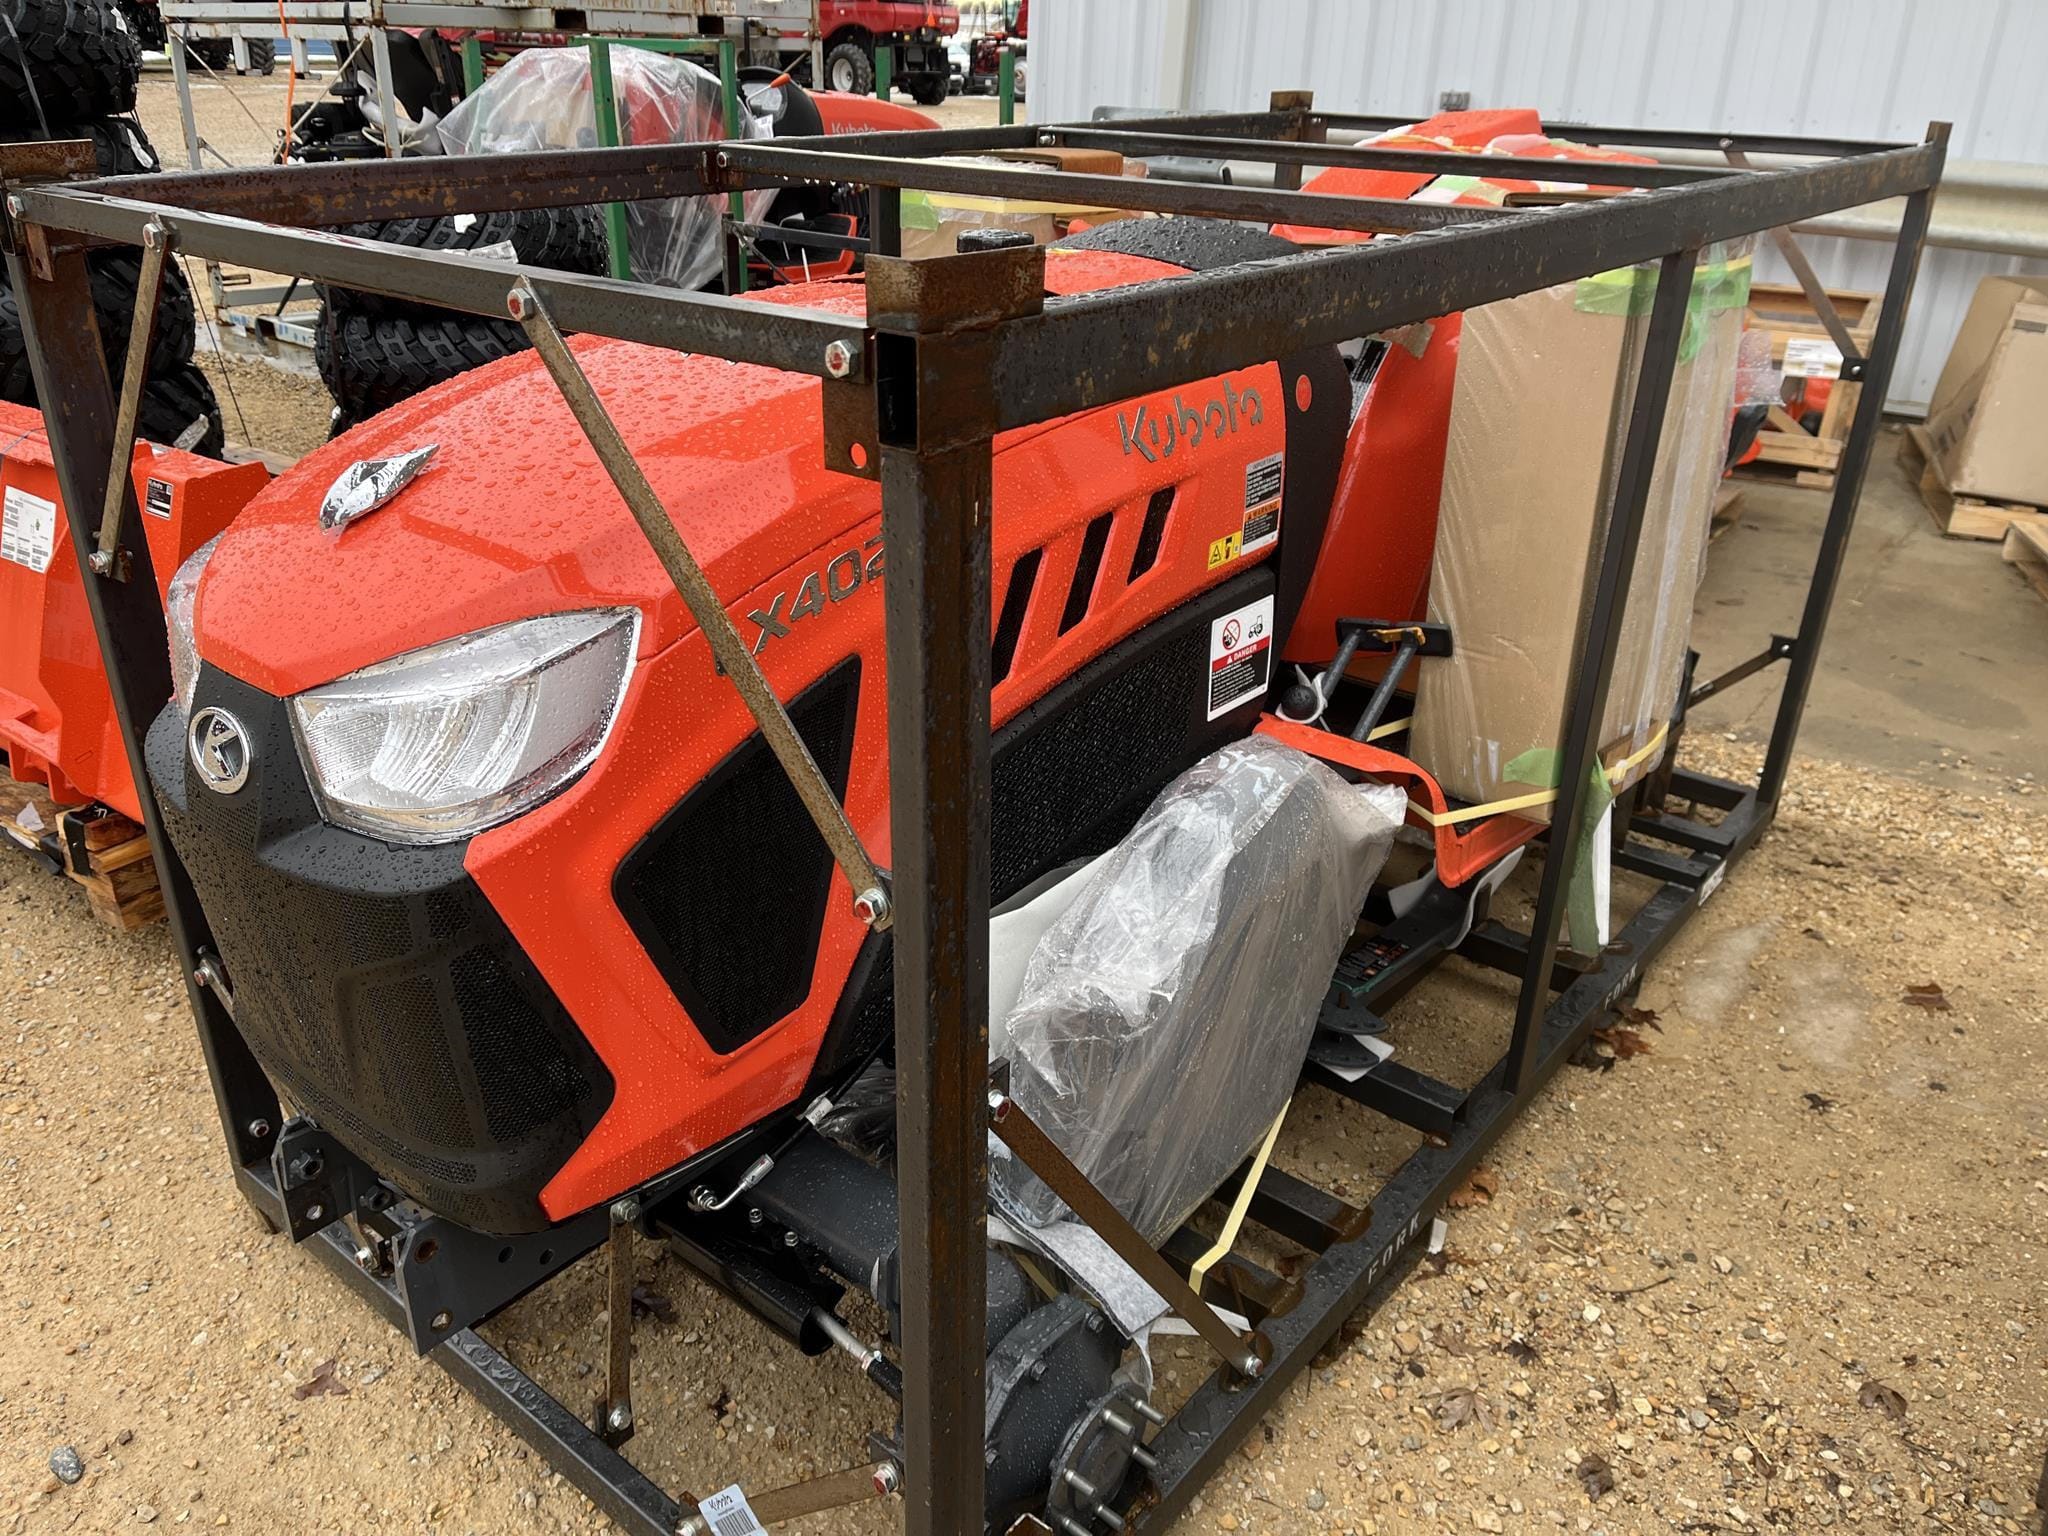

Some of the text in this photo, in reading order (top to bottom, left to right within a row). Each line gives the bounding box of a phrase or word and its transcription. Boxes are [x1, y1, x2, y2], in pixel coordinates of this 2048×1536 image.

[1117, 379, 1264, 463] Kubota
[1252, 501, 1278, 517] WARNING
[1233, 643, 1258, 660] DANGER
[1604, 962, 1638, 1010] FORK
[1368, 1211, 1420, 1285] FORK
